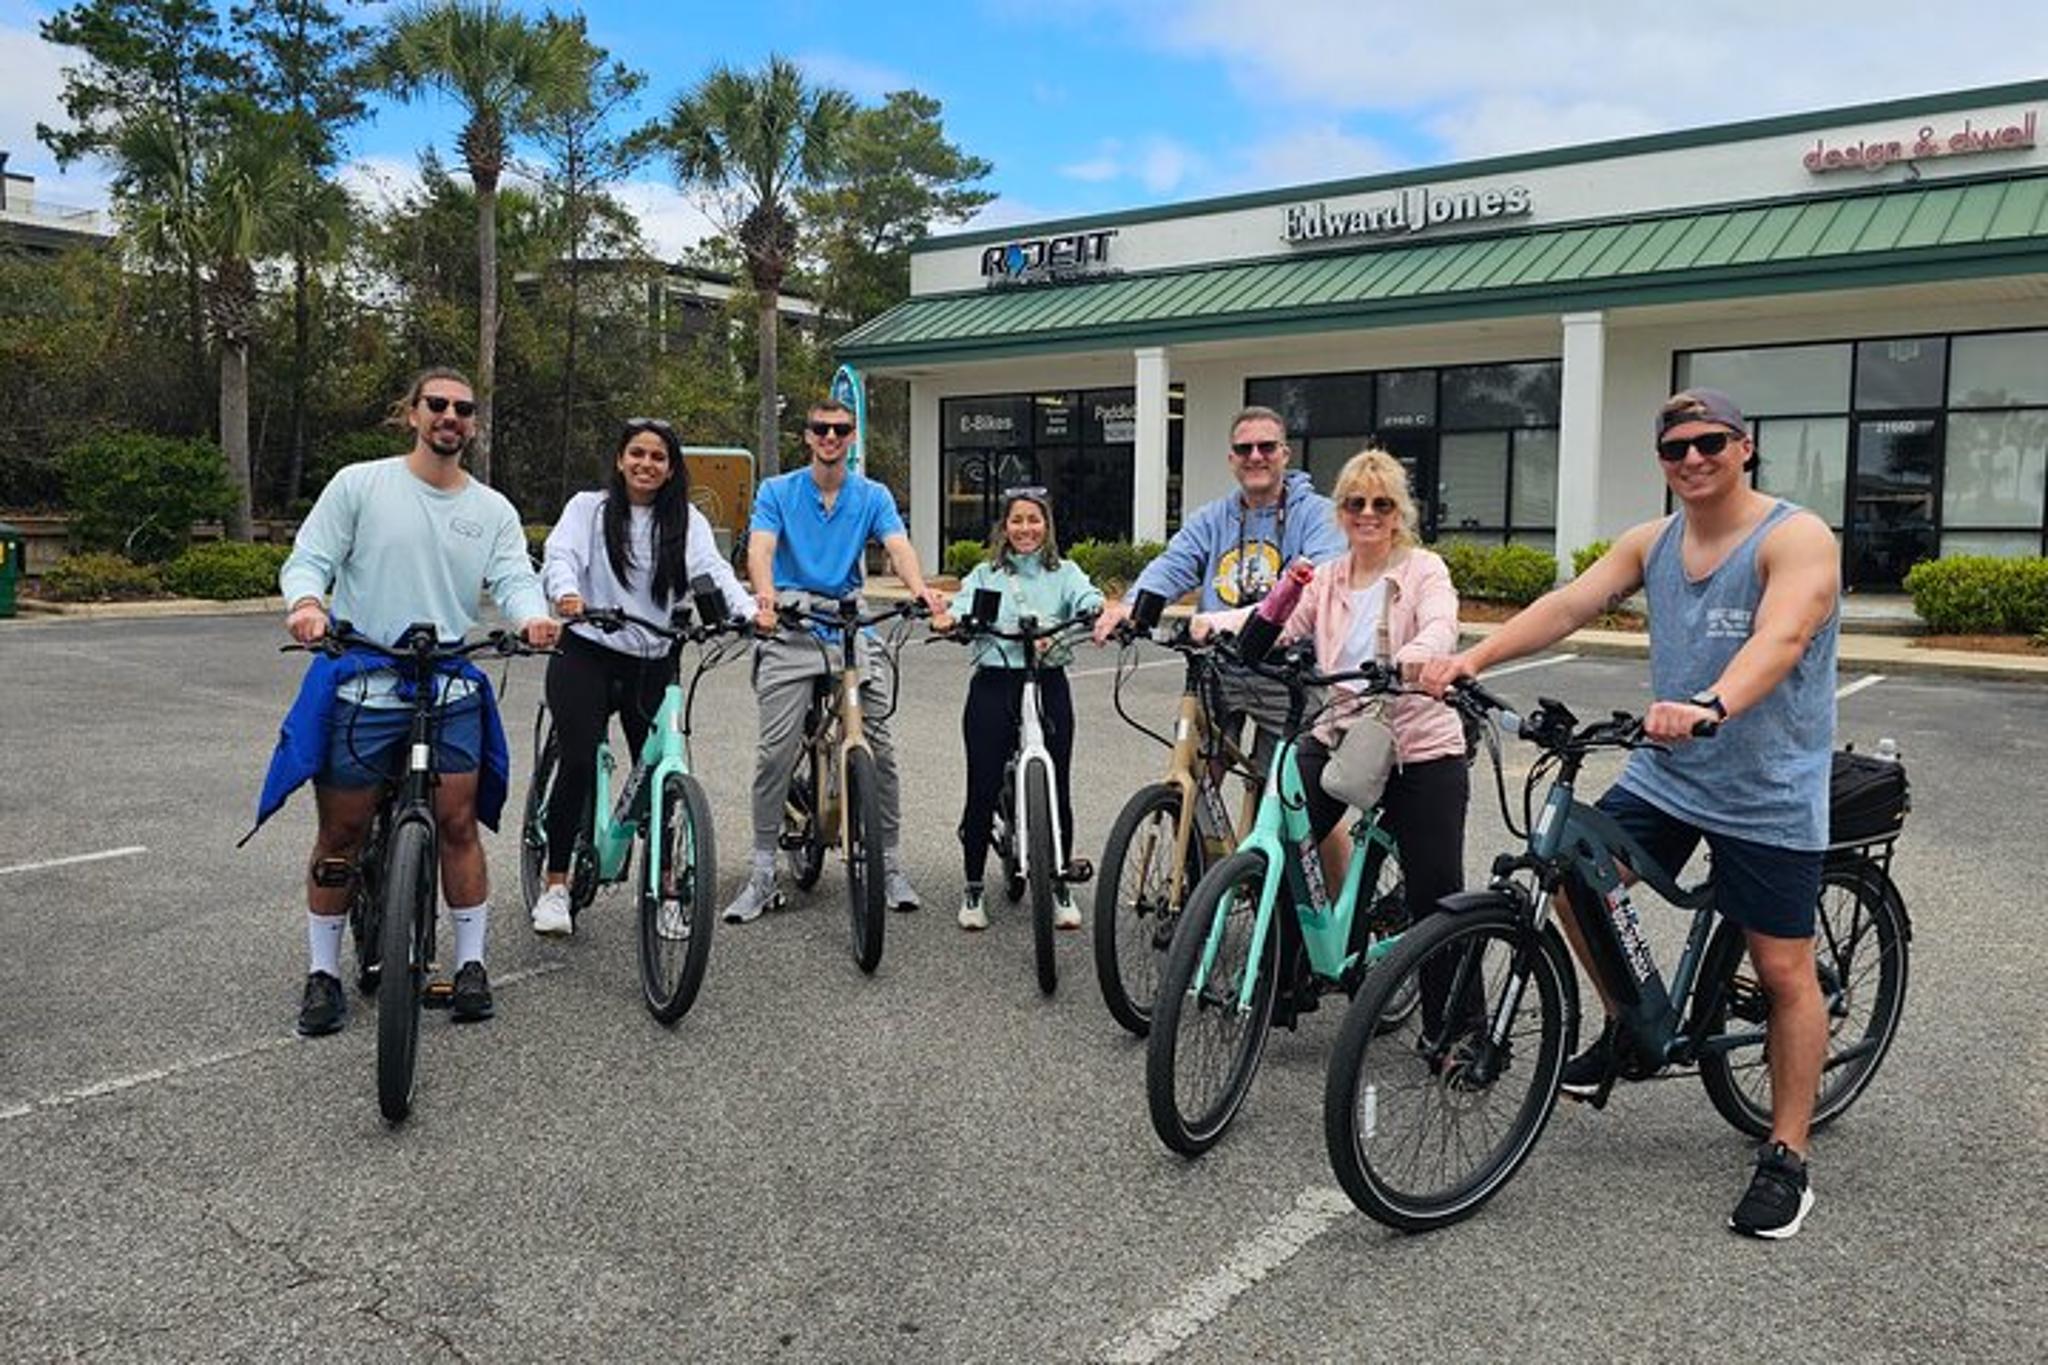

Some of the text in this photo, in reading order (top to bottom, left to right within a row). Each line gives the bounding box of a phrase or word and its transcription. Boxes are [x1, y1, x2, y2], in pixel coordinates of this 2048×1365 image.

[1803, 112, 2037, 172] design & dwell
[1283, 185, 1535, 241] Edward Jones
[960, 414, 1014, 432] E-Bikes
